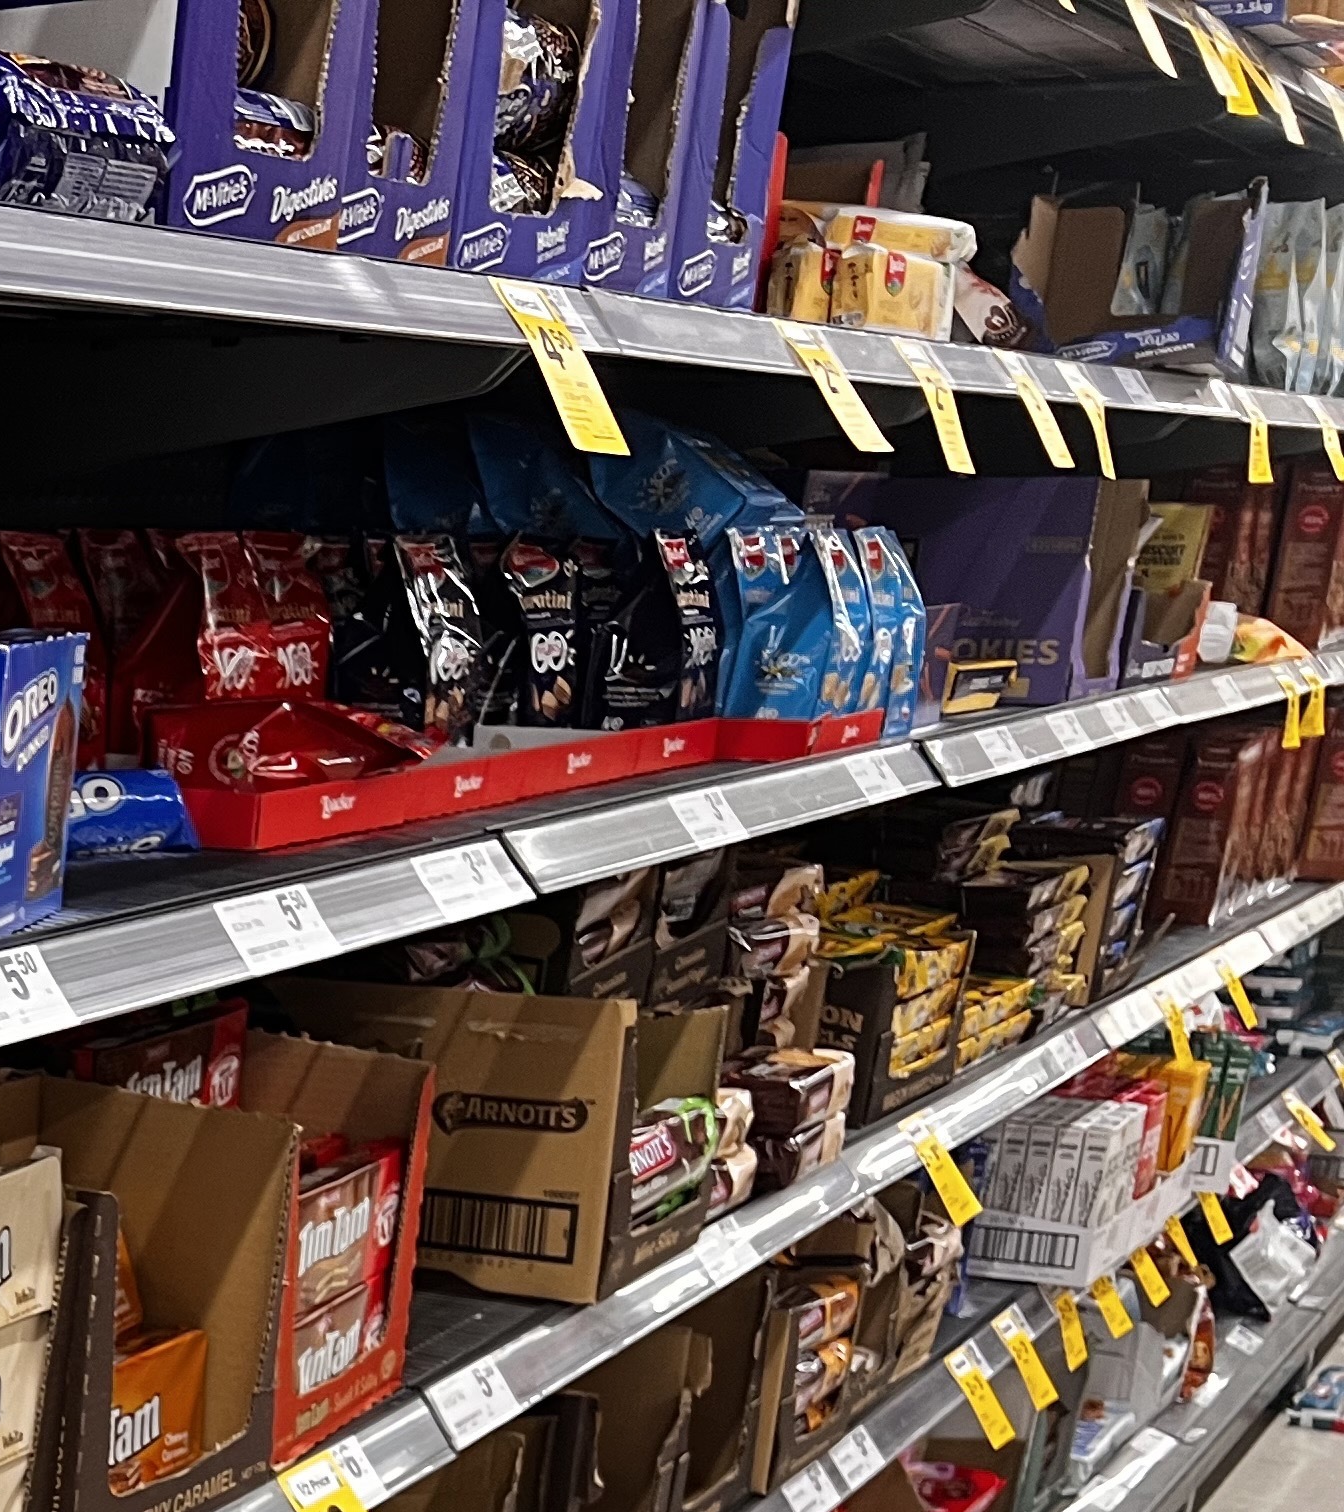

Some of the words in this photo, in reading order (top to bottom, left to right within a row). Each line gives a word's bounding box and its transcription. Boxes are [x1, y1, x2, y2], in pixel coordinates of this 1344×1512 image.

[269, 175, 338, 223] Digestives
[394, 199, 451, 242] Digestives
[2, 671, 59, 756] OREO
[462, 1097, 580, 1131] ARNOTT'S
[298, 1197, 372, 1277] TimTam
